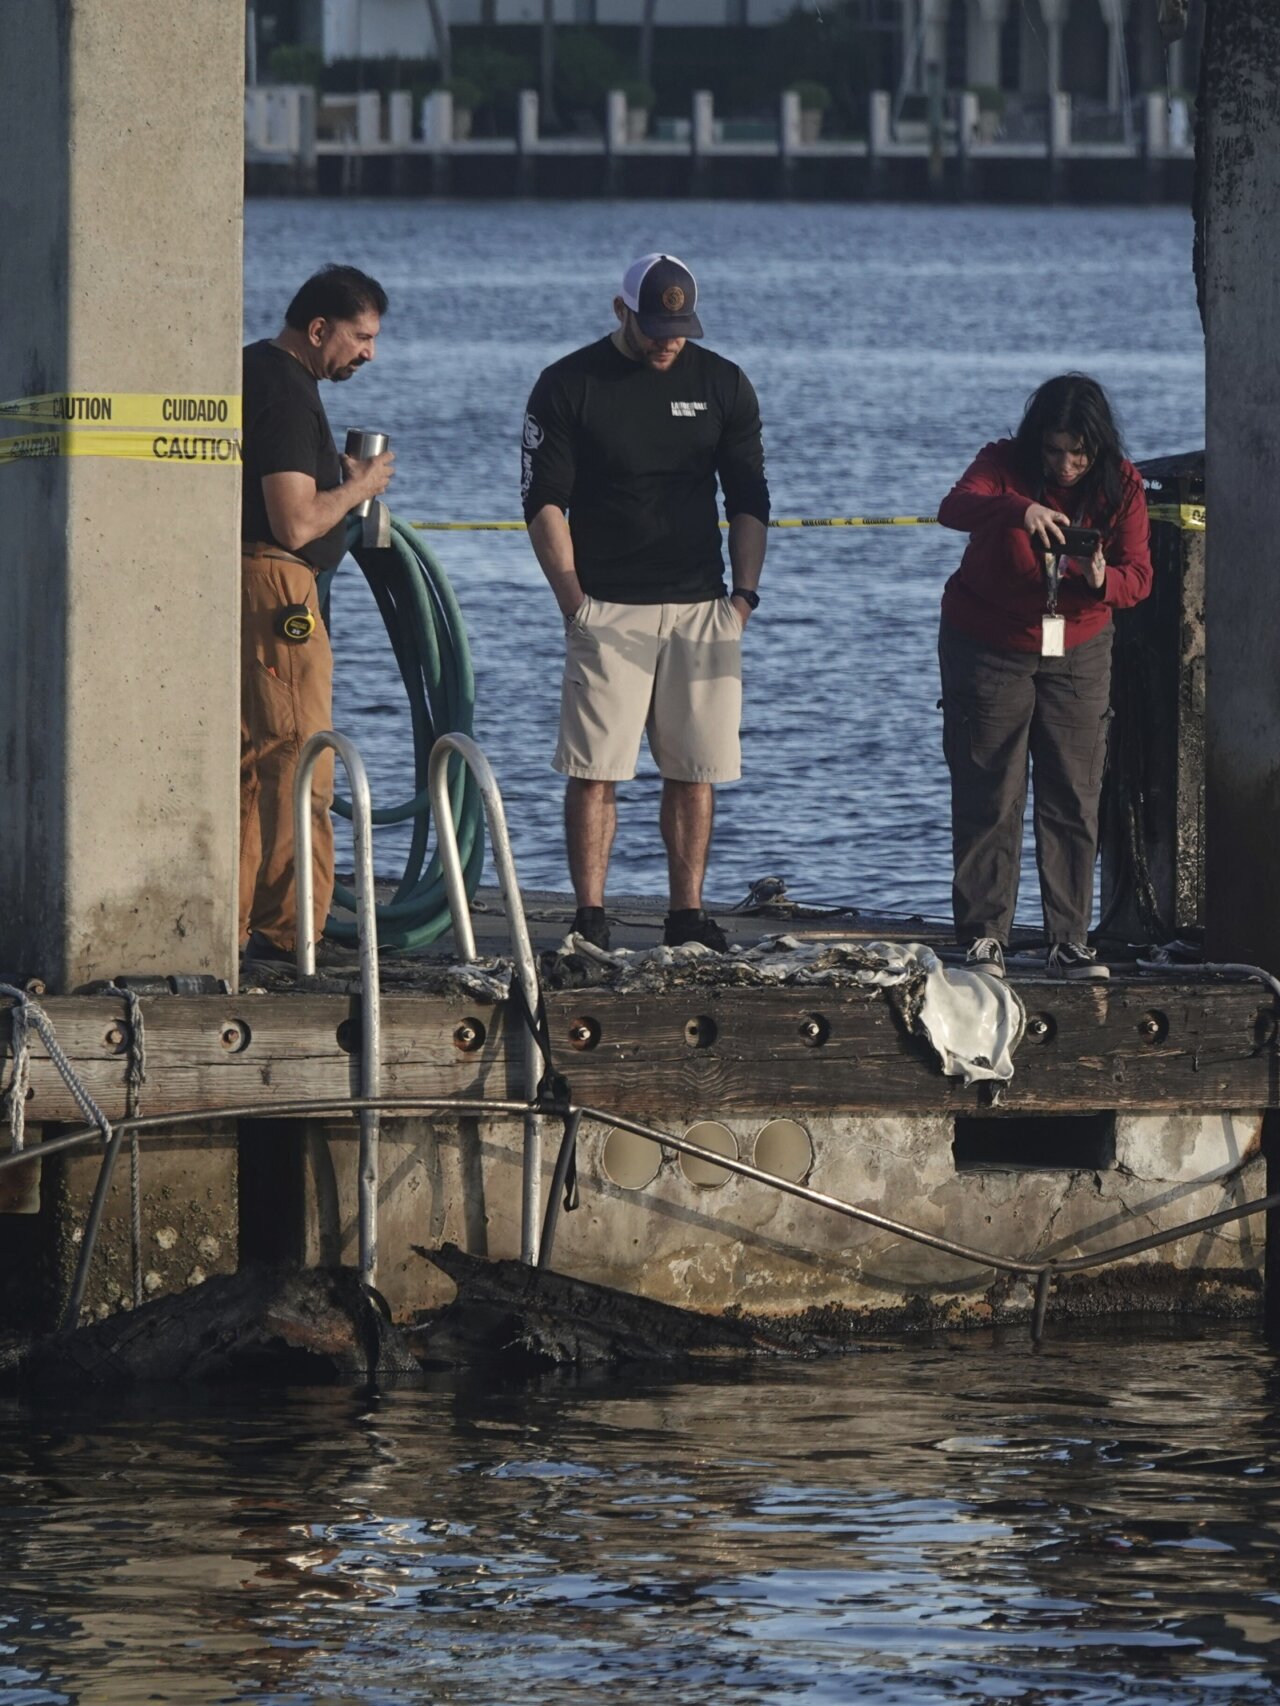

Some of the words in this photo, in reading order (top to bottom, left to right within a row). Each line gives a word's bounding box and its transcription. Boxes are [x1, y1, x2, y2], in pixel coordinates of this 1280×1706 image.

[53, 397, 112, 420] CAUTION
[162, 398, 228, 422] CUIDADO
[152, 436, 243, 461] CAUTION
